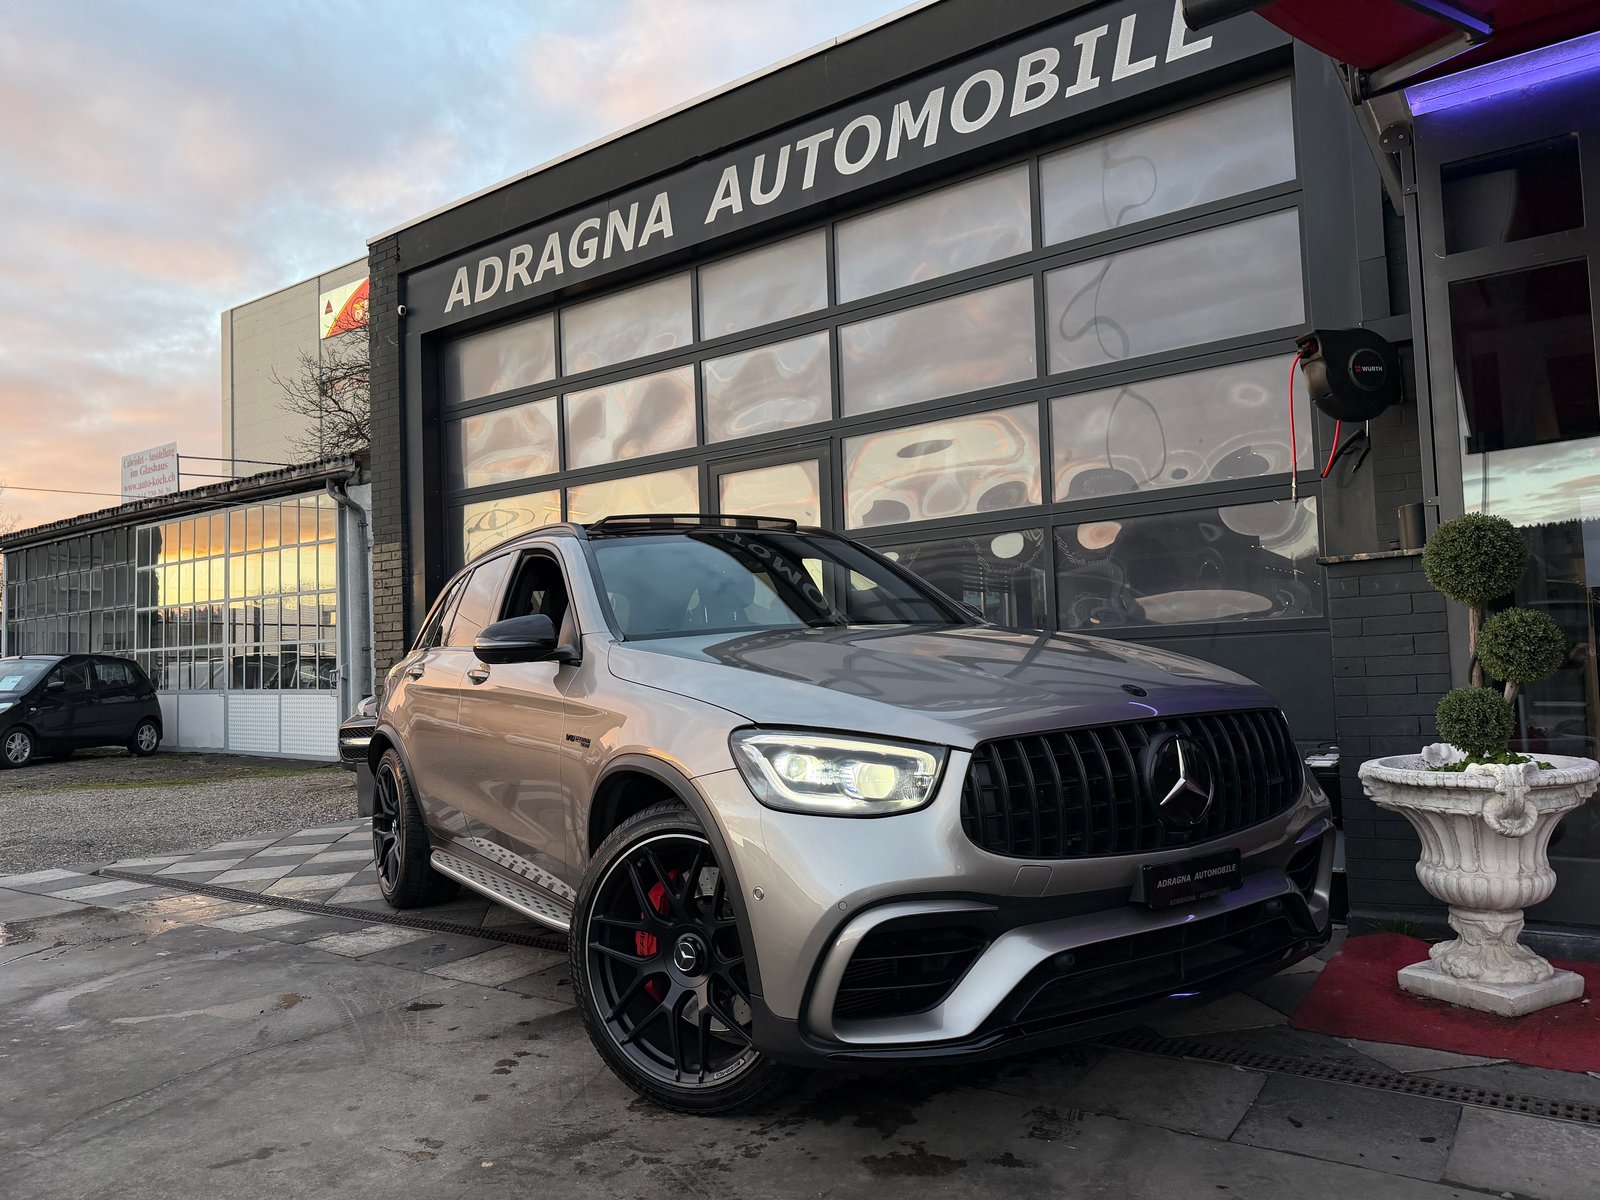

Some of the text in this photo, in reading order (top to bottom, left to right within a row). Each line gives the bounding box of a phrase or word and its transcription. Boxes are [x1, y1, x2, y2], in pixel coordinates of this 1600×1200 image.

[443, 191, 674, 314] ADRAGNA
[139, 462, 168, 476] Glashaus
[123, 472, 176, 492] www.auto-koch.ch
[1156, 863, 1237, 889] ADRAGNA AUTOMOBILE
